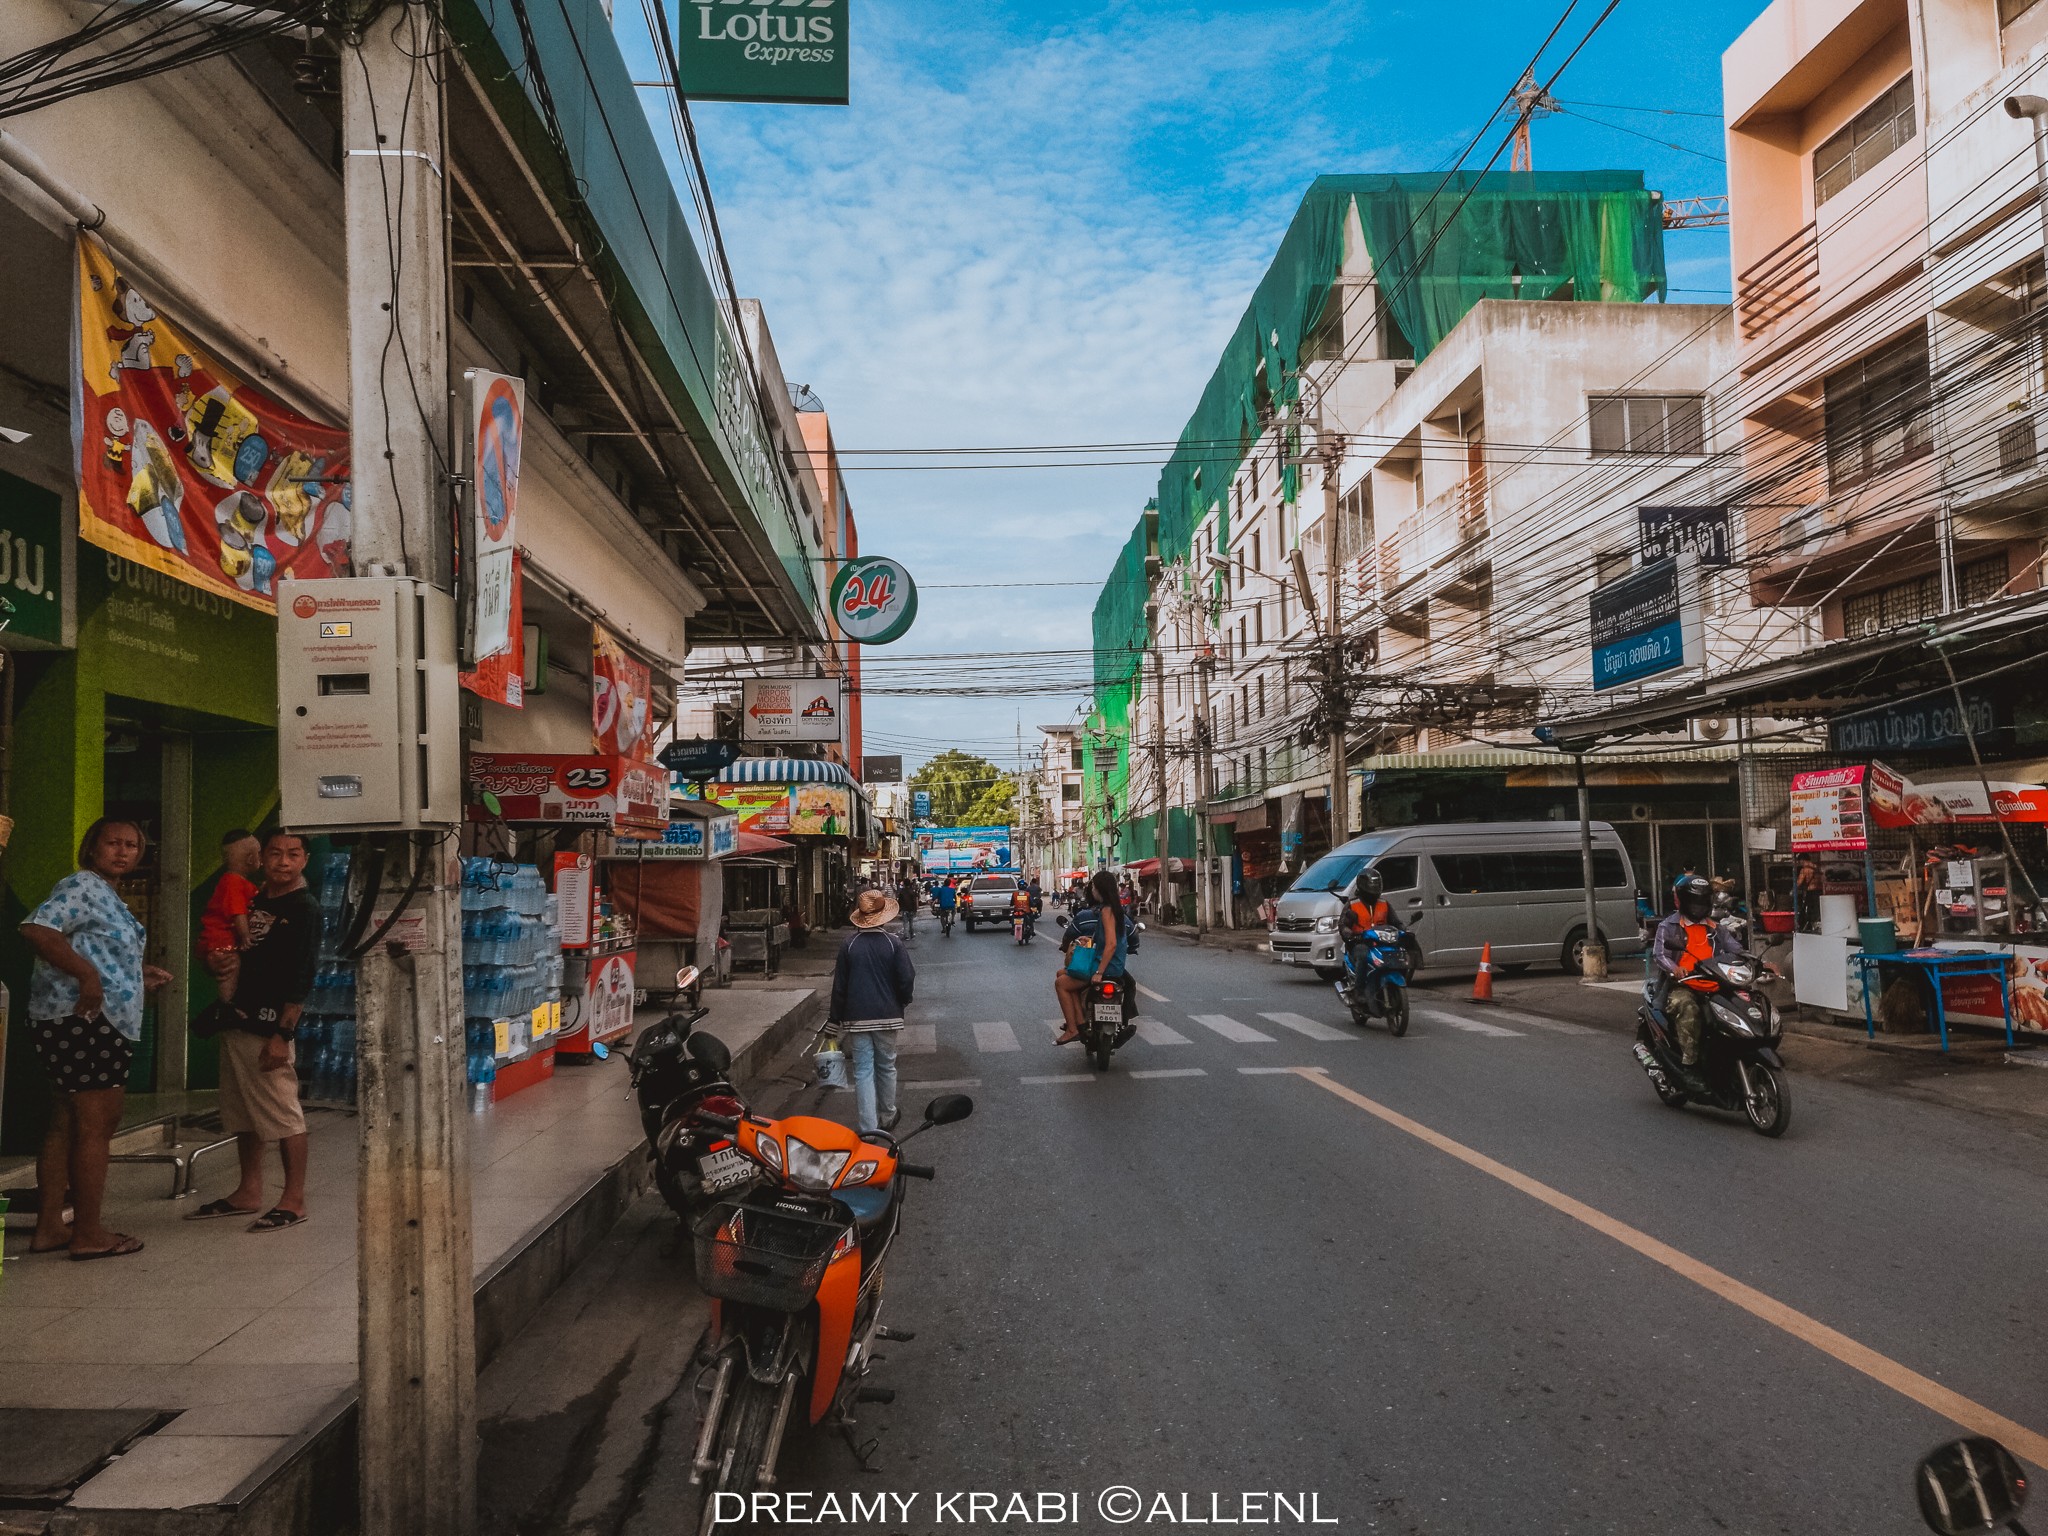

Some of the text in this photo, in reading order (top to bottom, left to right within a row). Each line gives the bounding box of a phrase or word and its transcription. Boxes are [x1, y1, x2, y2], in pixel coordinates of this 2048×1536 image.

[698, 6, 834, 43] Lotus
[744, 41, 834, 65] express
[844, 574, 896, 613] 24
[1663, 636, 1671, 655] 2
[757, 689, 791, 697] AIRPORT
[757, 714, 792, 725] ห้องพัก
[566, 768, 609, 788] 25
[1994, 798, 2037, 815] Carnation
[257, 1007, 277, 1022] SD
[775, 1200, 808, 1214] HONDA
